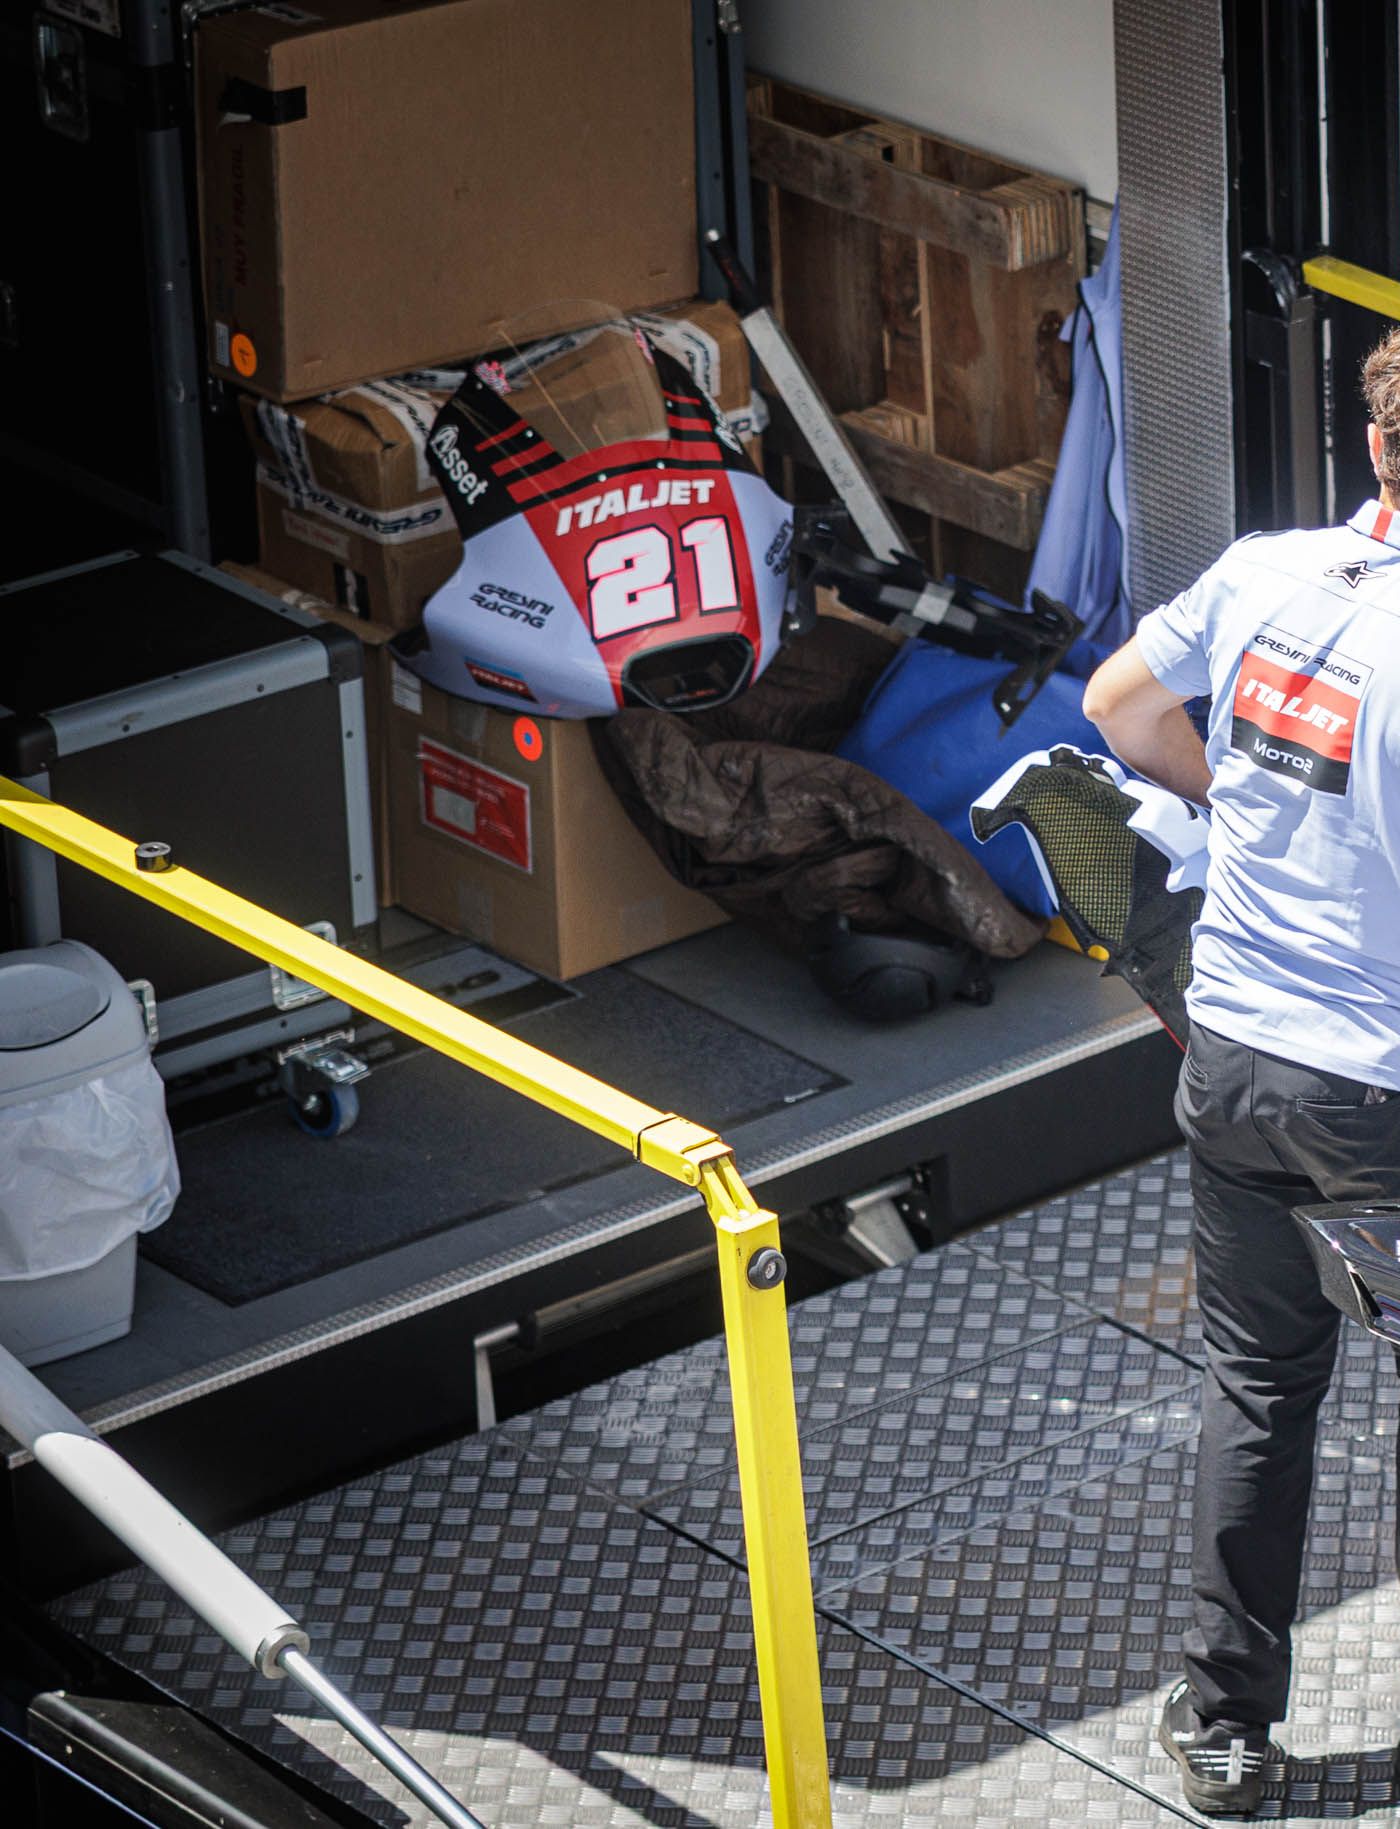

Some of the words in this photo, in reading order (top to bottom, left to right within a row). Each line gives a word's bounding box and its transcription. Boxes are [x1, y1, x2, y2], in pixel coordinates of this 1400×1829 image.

[555, 478, 716, 537] ITALJET
[478, 583, 555, 616] GRESINI
[584, 514, 742, 645] 21
[469, 593, 547, 630] RACING
[1253, 634, 1312, 665] GRESINI
[1313, 656, 1362, 686] RACING
[1241, 678, 1350, 737] ITALJET
